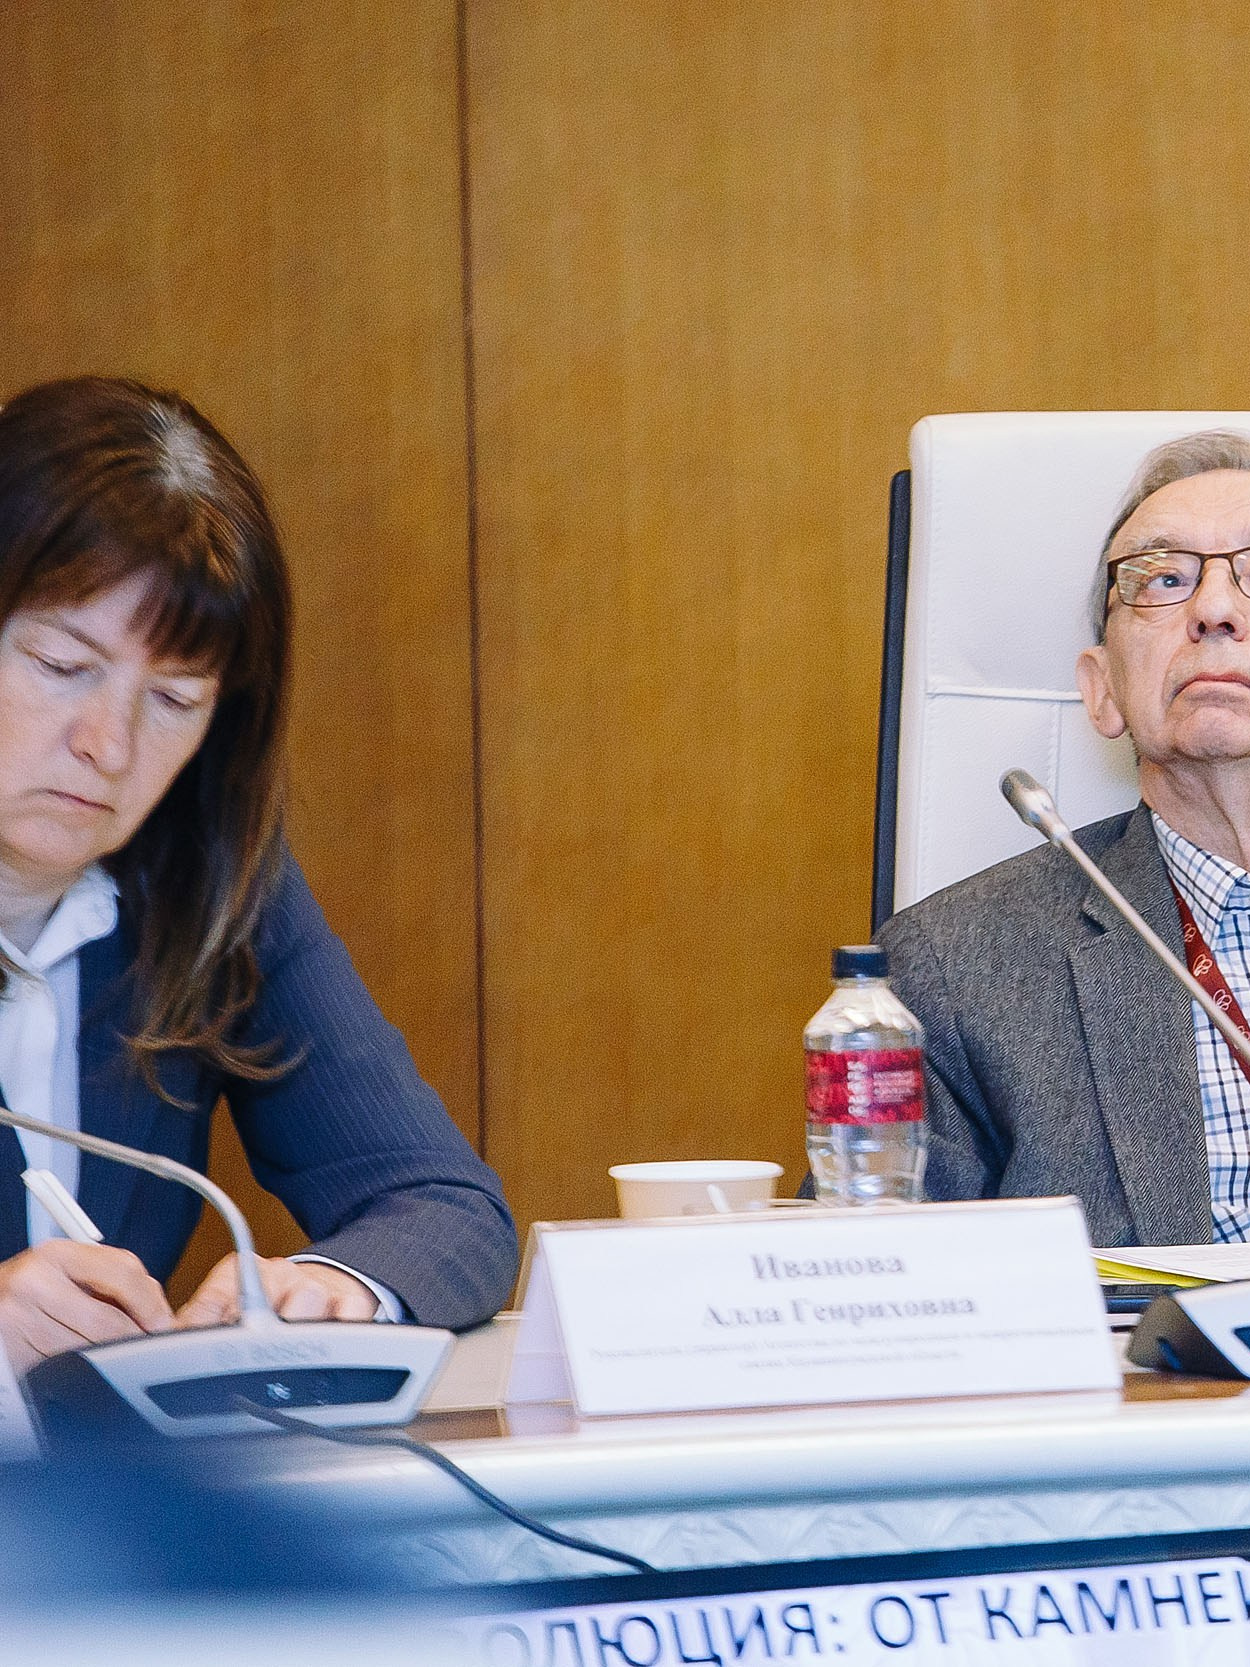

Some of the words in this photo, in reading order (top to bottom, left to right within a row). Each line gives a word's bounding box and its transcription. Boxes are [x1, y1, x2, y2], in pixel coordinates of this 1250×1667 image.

[751, 1252, 907, 1281] Иванова
[702, 1303, 783, 1329] Алла
[790, 1295, 978, 1327] Генриховна
[480, 1603, 846, 1667] ОЛЮЦИЯ:
[869, 1592, 951, 1648] ОТ
